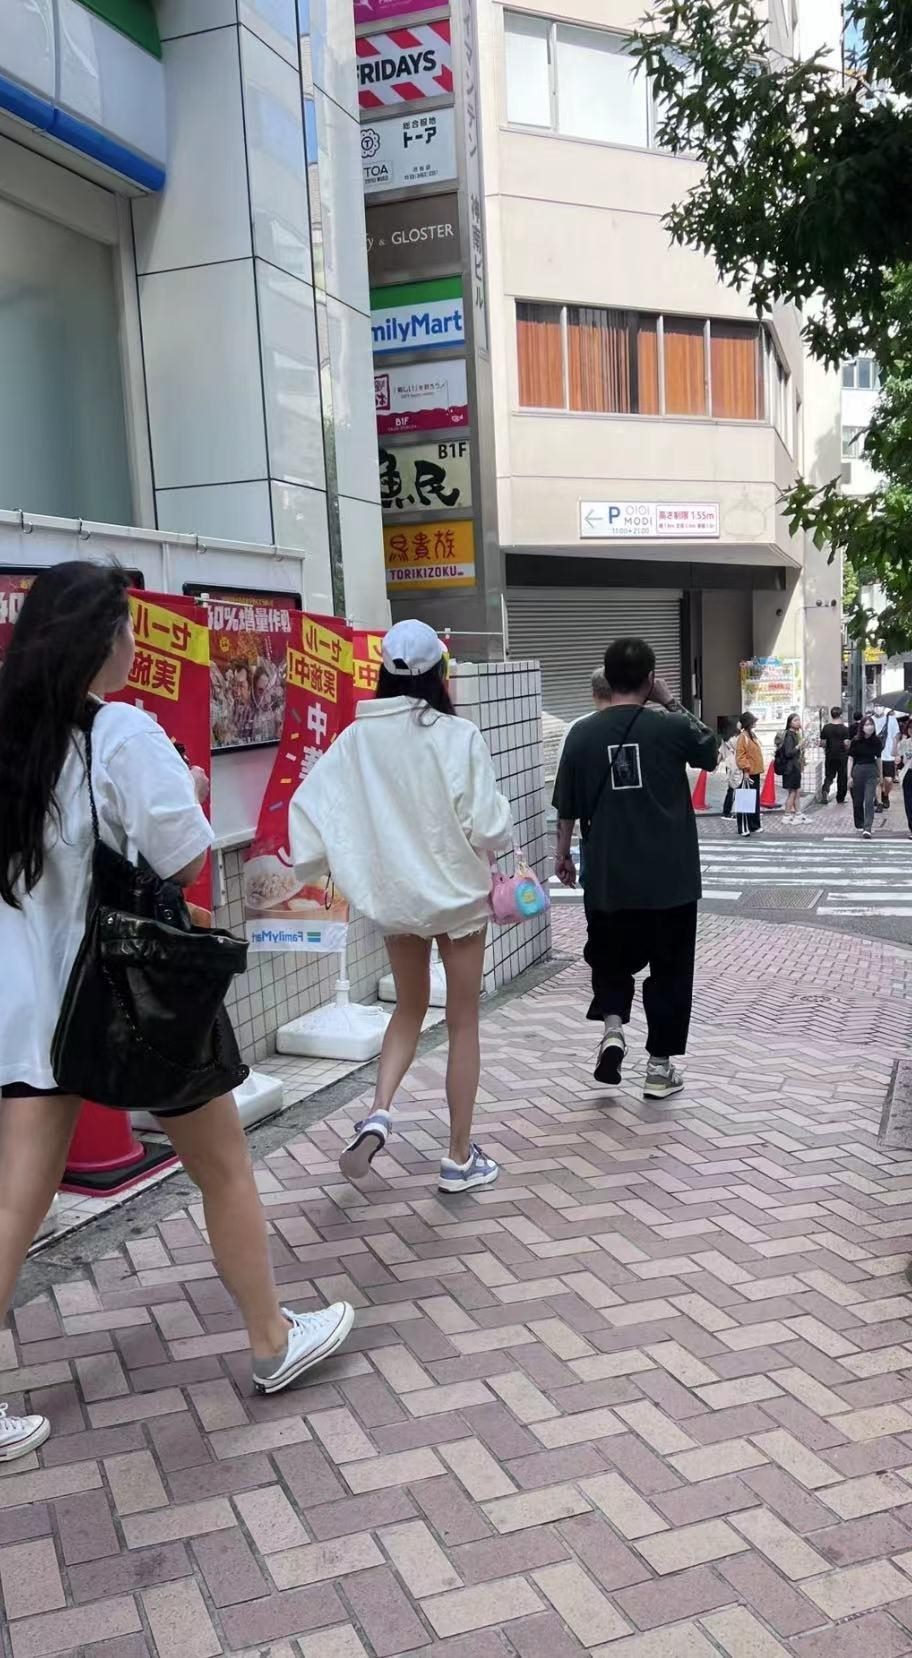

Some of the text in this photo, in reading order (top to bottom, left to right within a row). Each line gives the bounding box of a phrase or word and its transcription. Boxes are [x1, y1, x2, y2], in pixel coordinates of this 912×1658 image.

[403, 127, 437, 149] トーア
[363, 164, 389, 178] TOA
[391, 223, 454, 245] GLOSTER
[438, 442, 467, 459] B1F
[379, 447, 460, 509] 魚民
[608, 506, 621, 524] P
[624, 517, 653, 526] MODI
[389, 529, 456, 561] 鳥貴族
[390, 565, 457, 580] TORIKIZOKU
